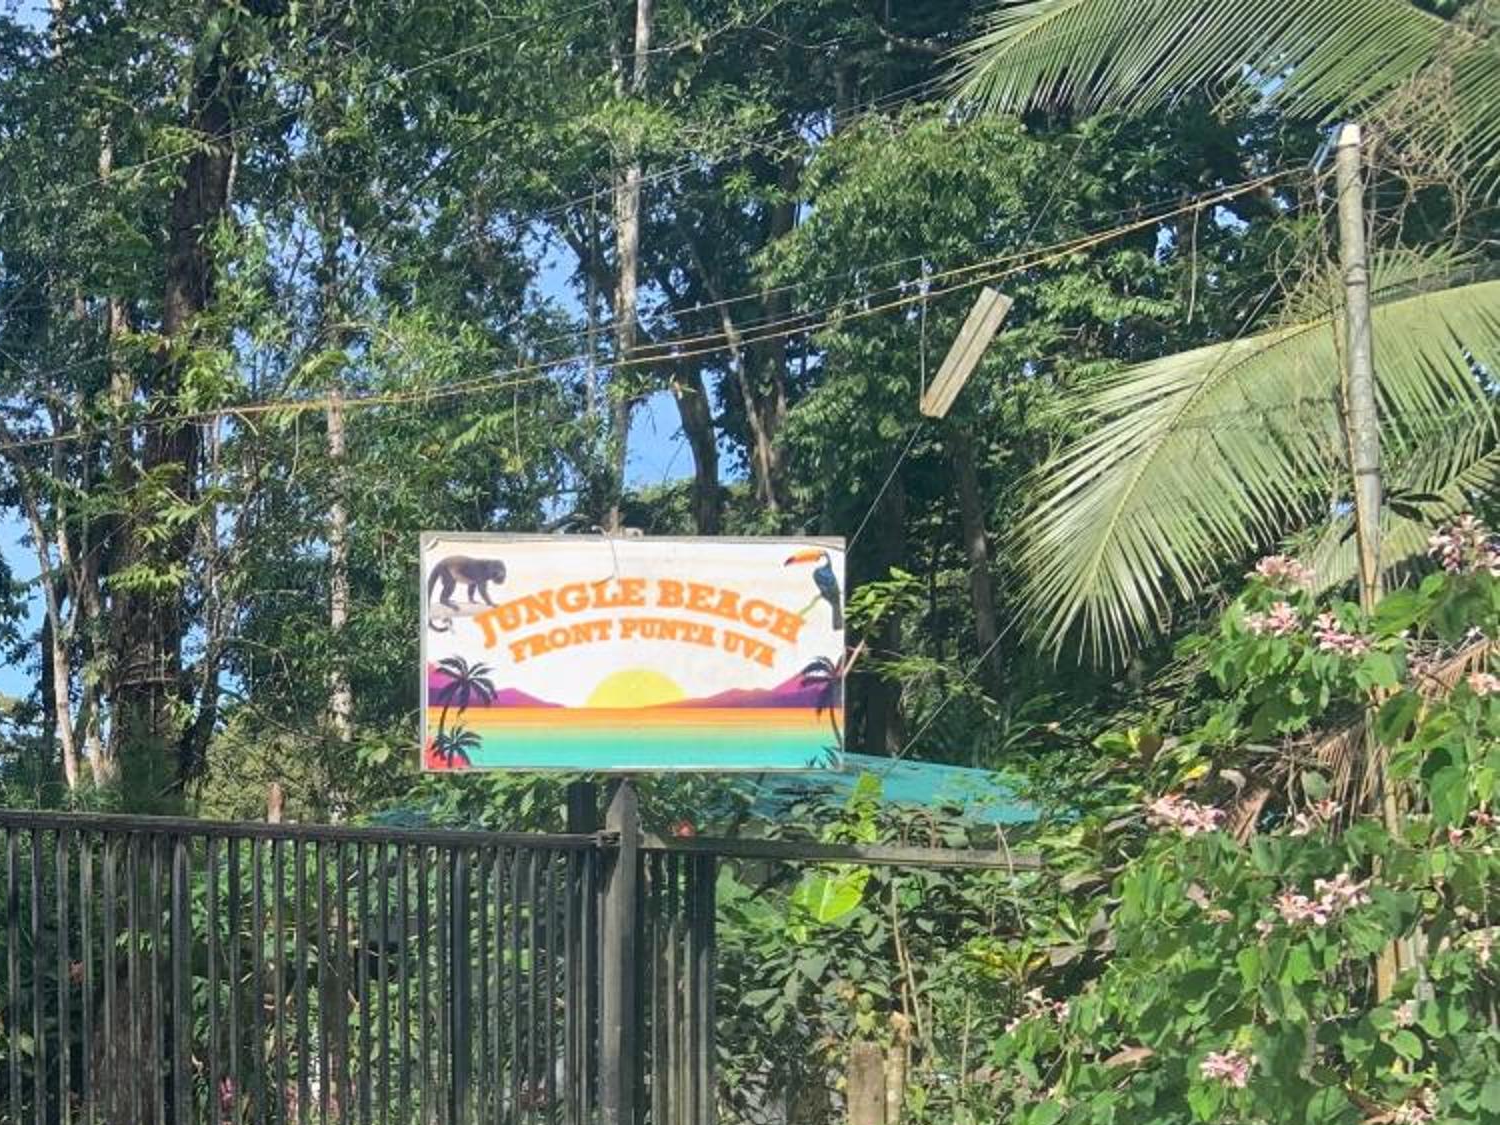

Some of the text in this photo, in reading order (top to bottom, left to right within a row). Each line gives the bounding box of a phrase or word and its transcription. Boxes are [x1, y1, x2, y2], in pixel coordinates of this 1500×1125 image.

[473, 577, 806, 649] JUNGLE BEACH
[508, 617, 776, 668] FRONT PUNTA UVA
